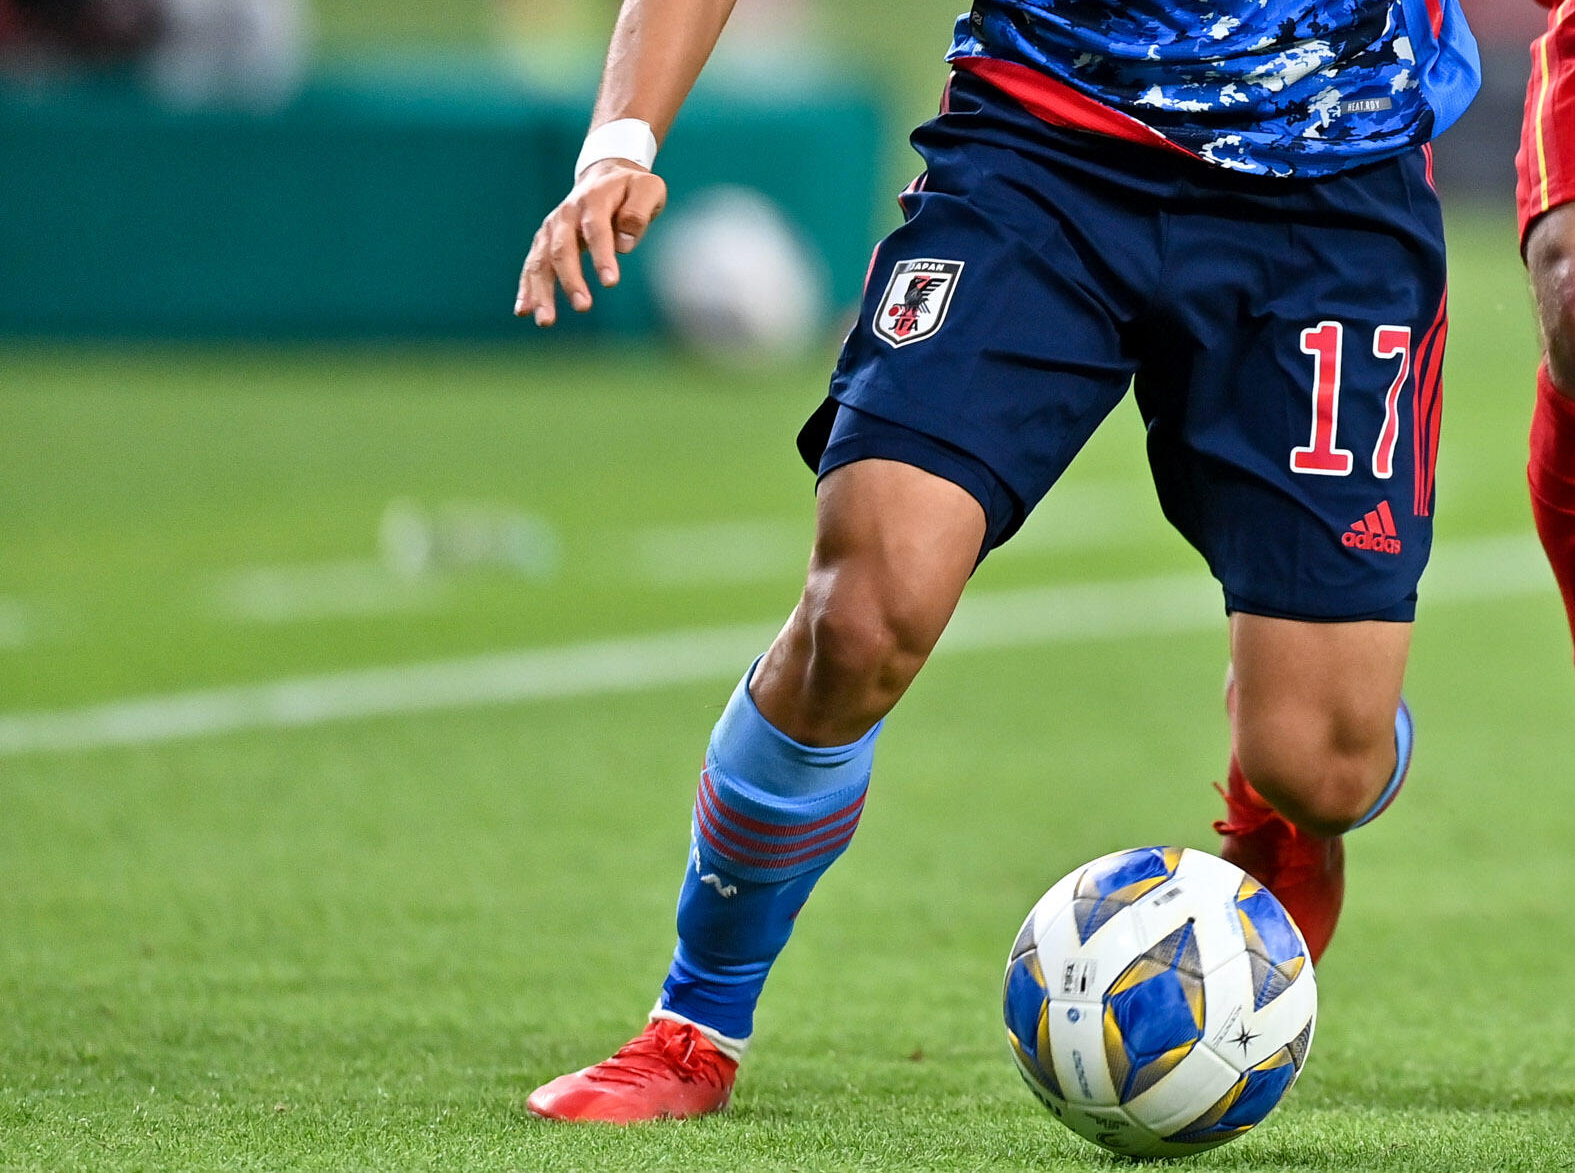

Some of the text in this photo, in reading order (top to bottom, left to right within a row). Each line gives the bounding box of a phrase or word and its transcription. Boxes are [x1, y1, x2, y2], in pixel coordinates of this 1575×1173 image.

[1347, 100, 1381, 112] HEAT.RDY
[909, 262, 945, 271] JAPAN
[888, 318, 919, 332] JFA
[1290, 321, 1411, 479] 17
[1341, 530, 1402, 555] adidas
